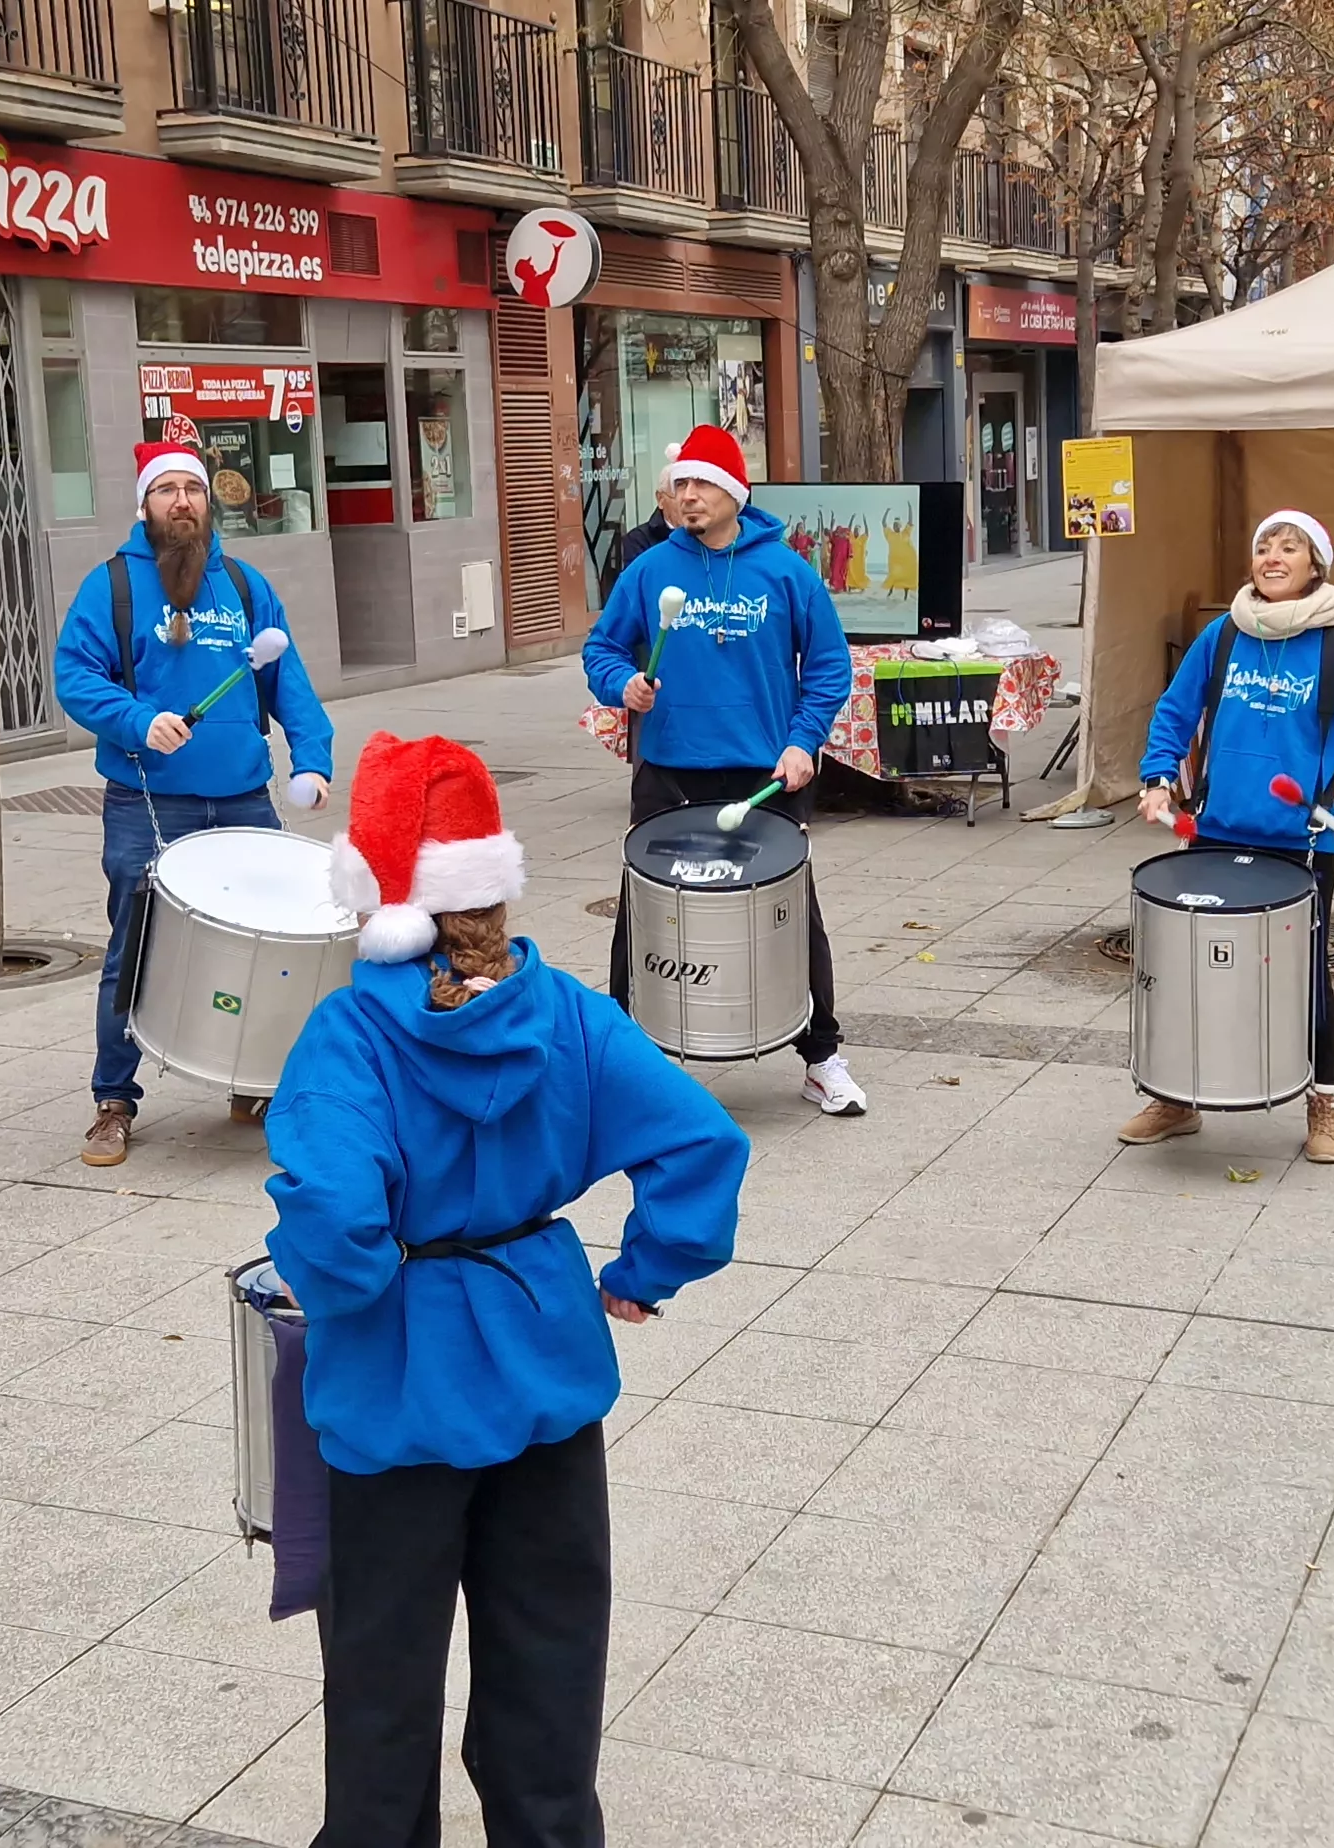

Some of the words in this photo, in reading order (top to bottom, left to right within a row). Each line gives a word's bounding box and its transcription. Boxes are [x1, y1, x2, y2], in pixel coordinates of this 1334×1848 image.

[215, 197, 250, 228] 974
[253, 202, 286, 232] 226
[289, 207, 319, 236] 399
[192, 234, 324, 285] telepizza.es
[202, 379, 221, 389] TODA
[222, 380, 231, 389] LA
[231, 380, 251, 389] PIZZA
[210, 434, 246, 444] MAESTRAS
[596, 443, 607, 459] de
[915, 699, 989, 726] MILAR
[644, 951, 719, 986] GOPE
